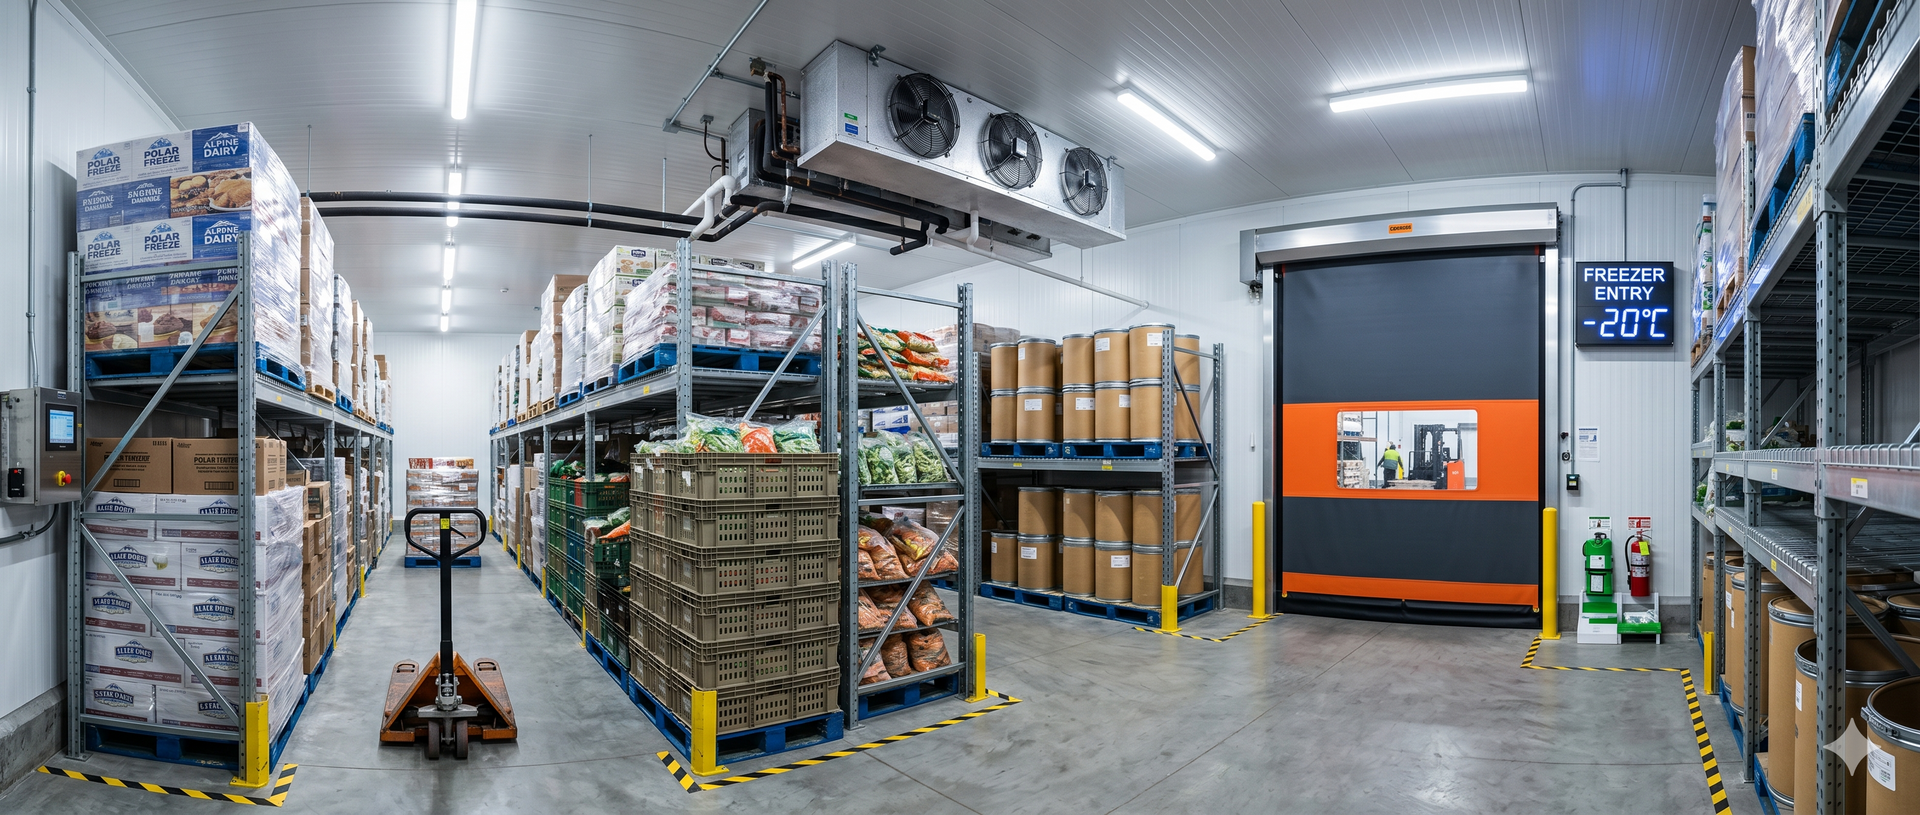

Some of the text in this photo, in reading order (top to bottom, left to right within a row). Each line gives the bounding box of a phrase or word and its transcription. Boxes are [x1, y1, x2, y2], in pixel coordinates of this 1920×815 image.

[203, 137, 239, 149] ALPINE
[144, 146, 179, 159] POLAR
[204, 146, 239, 158] DAIRY
[87, 156, 120, 169] POLAR
[144, 153, 180, 167] FREEZE
[87, 164, 121, 177] FREEZE
[144, 232, 180, 244] POLAR
[204, 233, 239, 245] DAIRY
[87, 240, 120, 252] POLAR
[144, 240, 180, 252] FREEZE
[87, 248, 121, 260] FREEZE
[1584, 268, 1665, 282] FREEZER
[1595, 286, 1654, 301] ENTRY
[1584, 308, 1668, 337] -20°C
